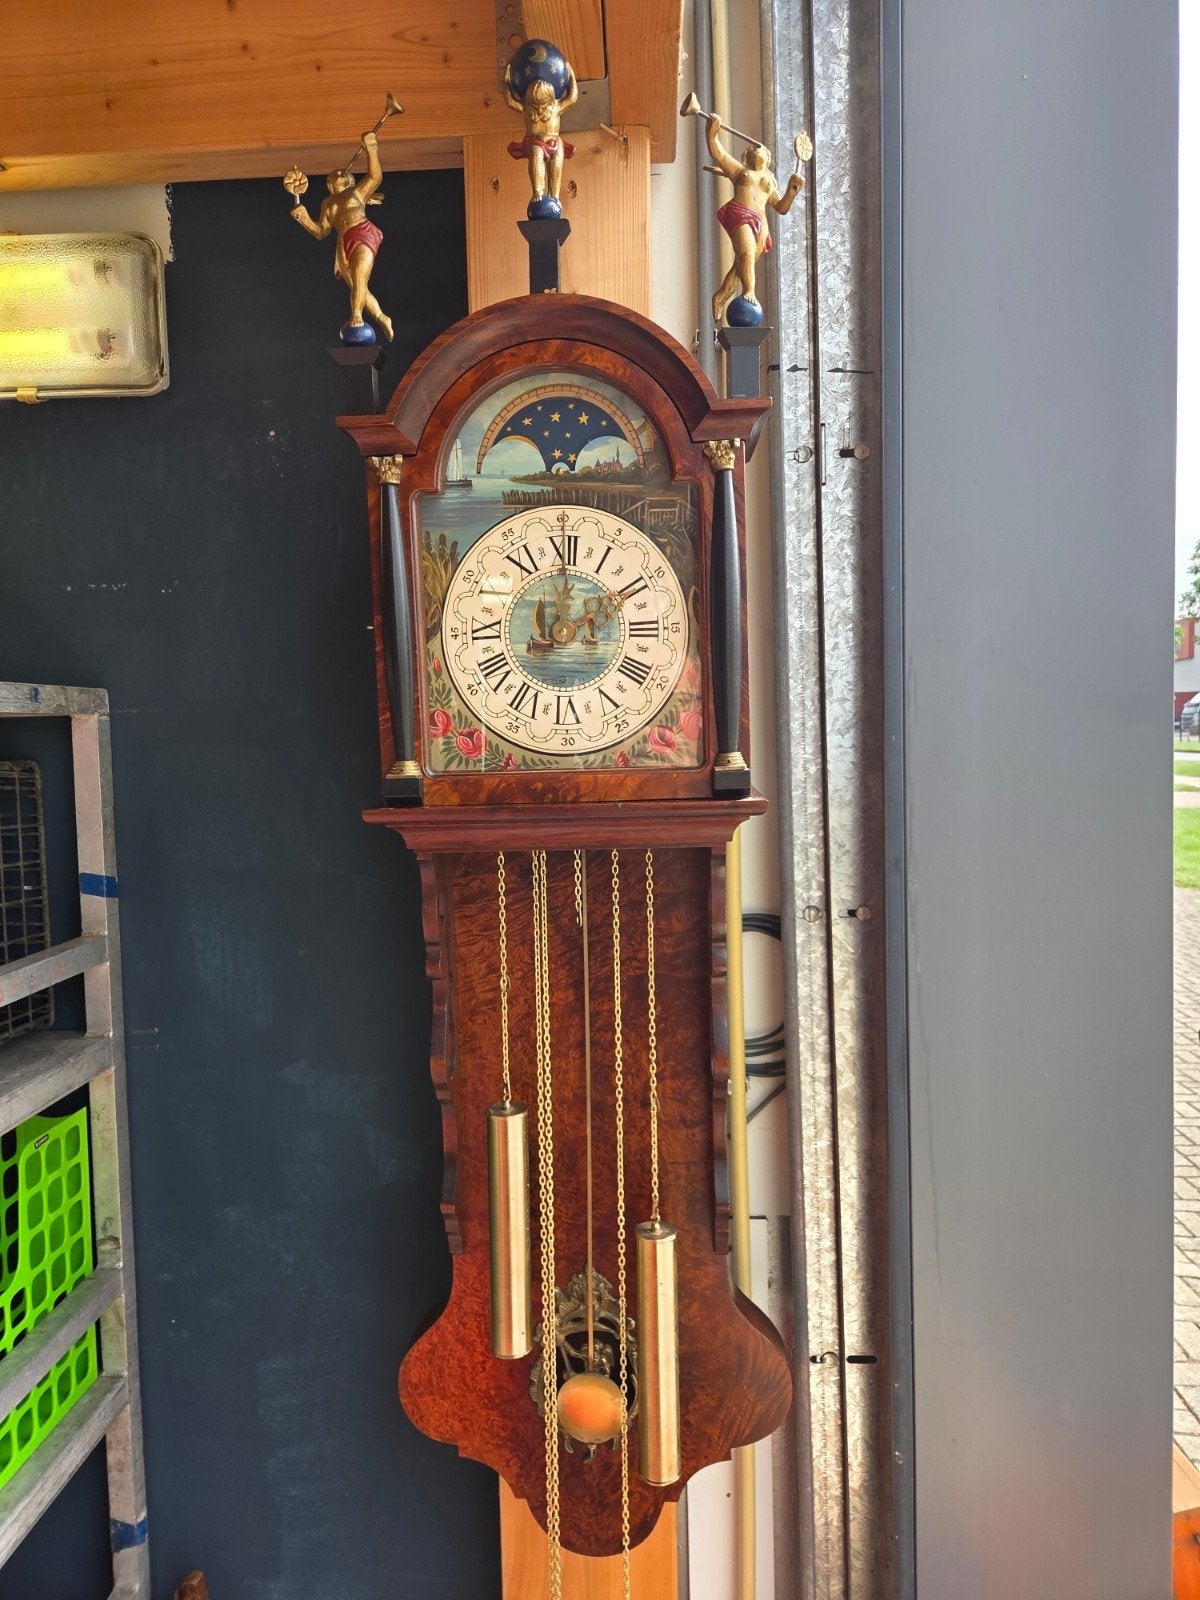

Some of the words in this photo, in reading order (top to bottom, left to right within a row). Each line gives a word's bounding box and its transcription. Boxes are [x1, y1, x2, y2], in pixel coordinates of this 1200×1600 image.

[501, 528, 515, 541] 55
[614, 527, 624, 537] 5
[546, 535, 581, 567] XII
[502, 542, 541, 582] XI
[593, 545, 614, 575] I
[462, 570, 475, 584] 50
[654, 566, 665, 578] 10
[450, 627, 459, 640] 45
[472, 616, 502, 645] IX
[628, 615, 659, 642] III
[670, 621, 680, 634] 15
[476, 650, 517, 695] VIII
[466, 683, 478, 696] 40
[656, 676, 669, 691] 20
[507, 680, 543, 720] VII
[593, 684, 624, 717] V
[553, 695, 582, 725] VI
[505, 722, 520, 734] 35
[615, 719, 629, 733] 25
[560, 737, 575, 746] 30
